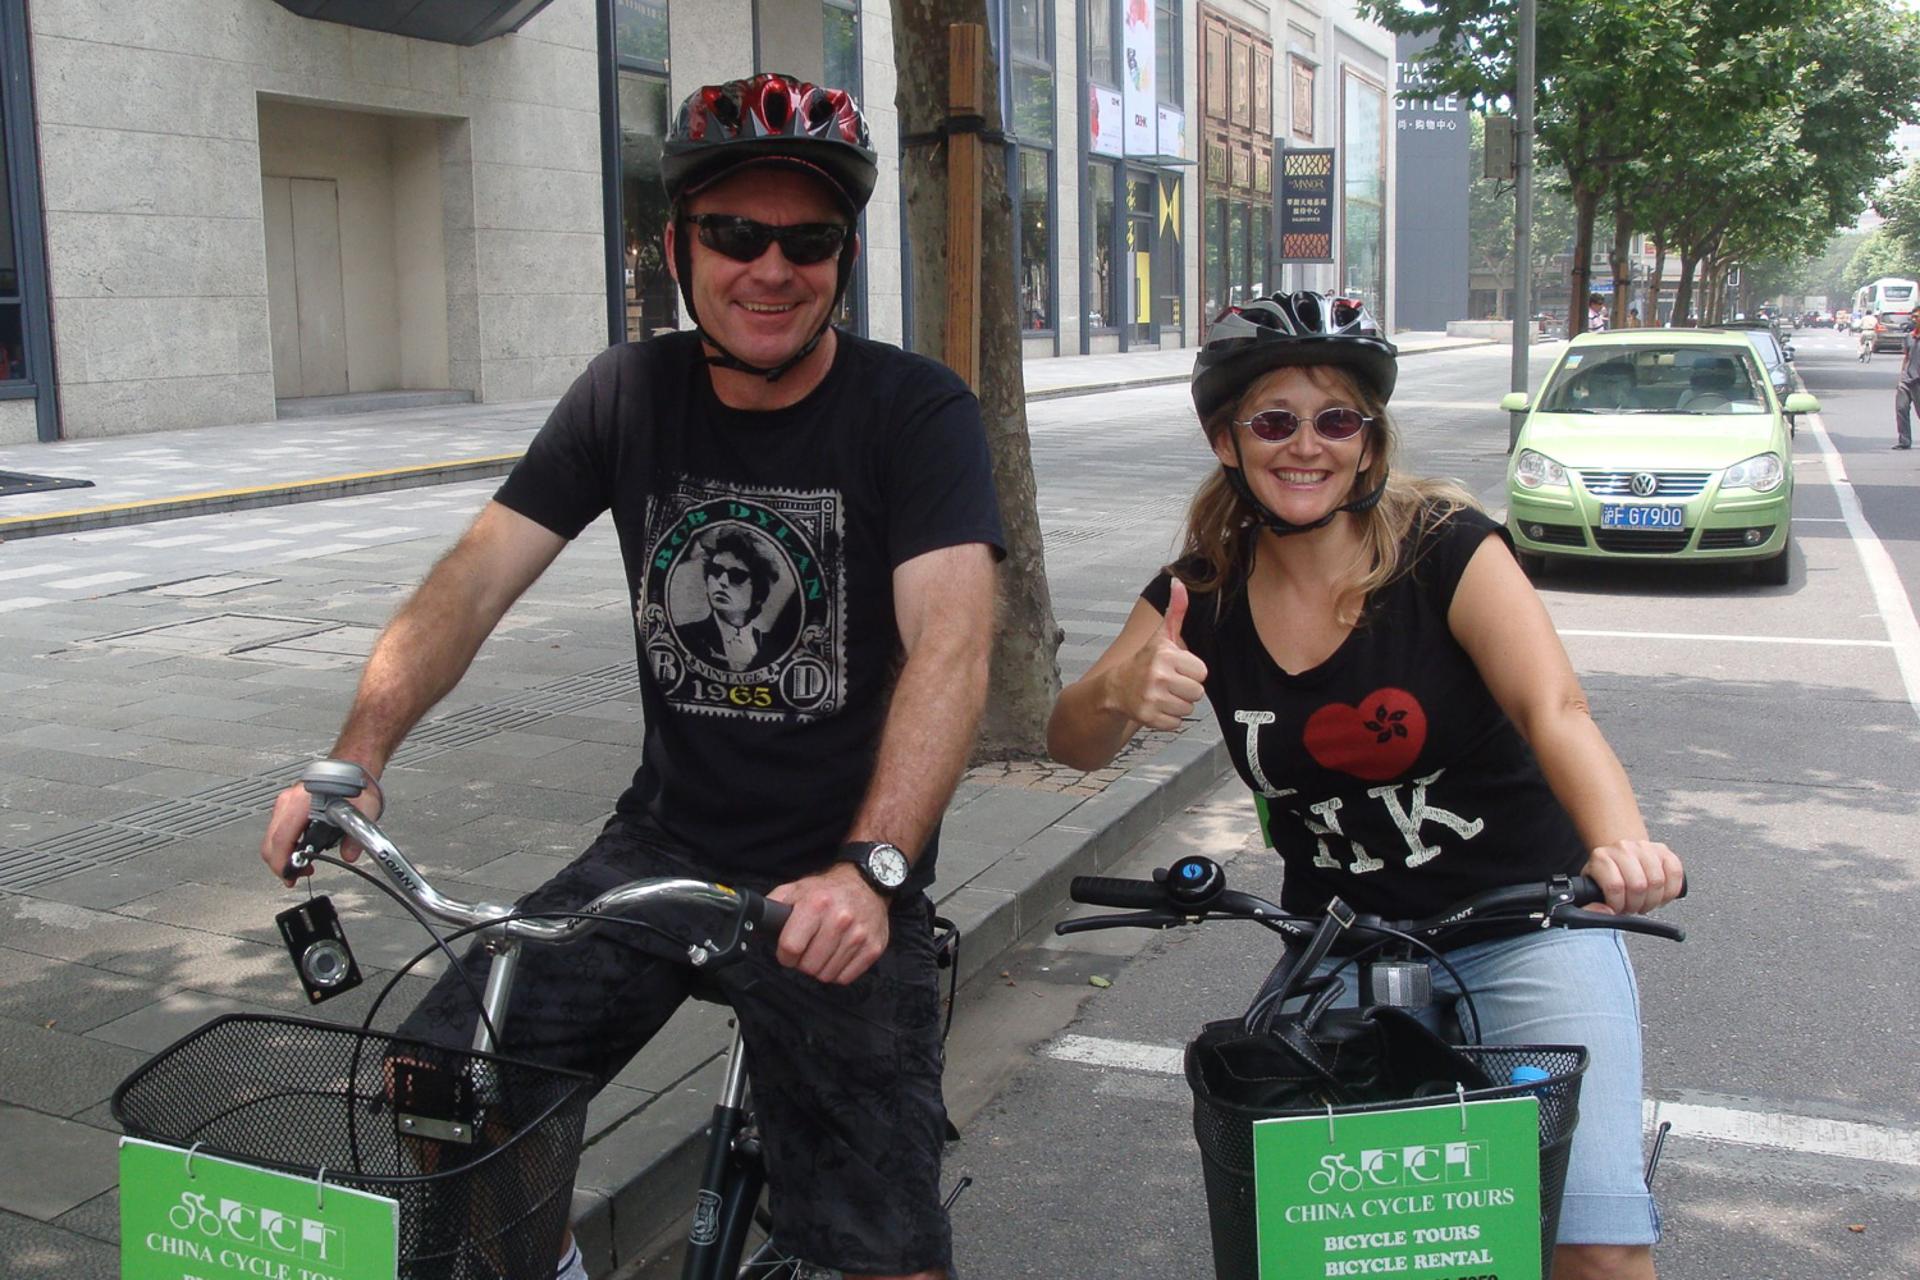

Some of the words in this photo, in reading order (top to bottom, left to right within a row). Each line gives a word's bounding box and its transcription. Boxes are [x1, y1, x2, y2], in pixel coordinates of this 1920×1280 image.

[1629, 507, 1682, 526] G7900
[654, 509, 709, 570] BOB
[728, 502, 824, 602] DYLAN
[696, 659, 766, 684] VINTAGE
[692, 679, 773, 708] 1965
[1234, 710, 1298, 799] I
[1285, 1201, 1356, 1224] CHINA
[1361, 1193, 1436, 1218] CYCLE
[1444, 1187, 1515, 1210] TOURS
[1324, 1230, 1408, 1252] BICYCLE
[1413, 1224, 1481, 1245] TOURS
[146, 1232, 215, 1264] CHINA
[219, 1249, 290, 1280] CYCLE
[1325, 1255, 1409, 1278] BICYCLE
[1413, 1249, 1494, 1271] RENTAL
